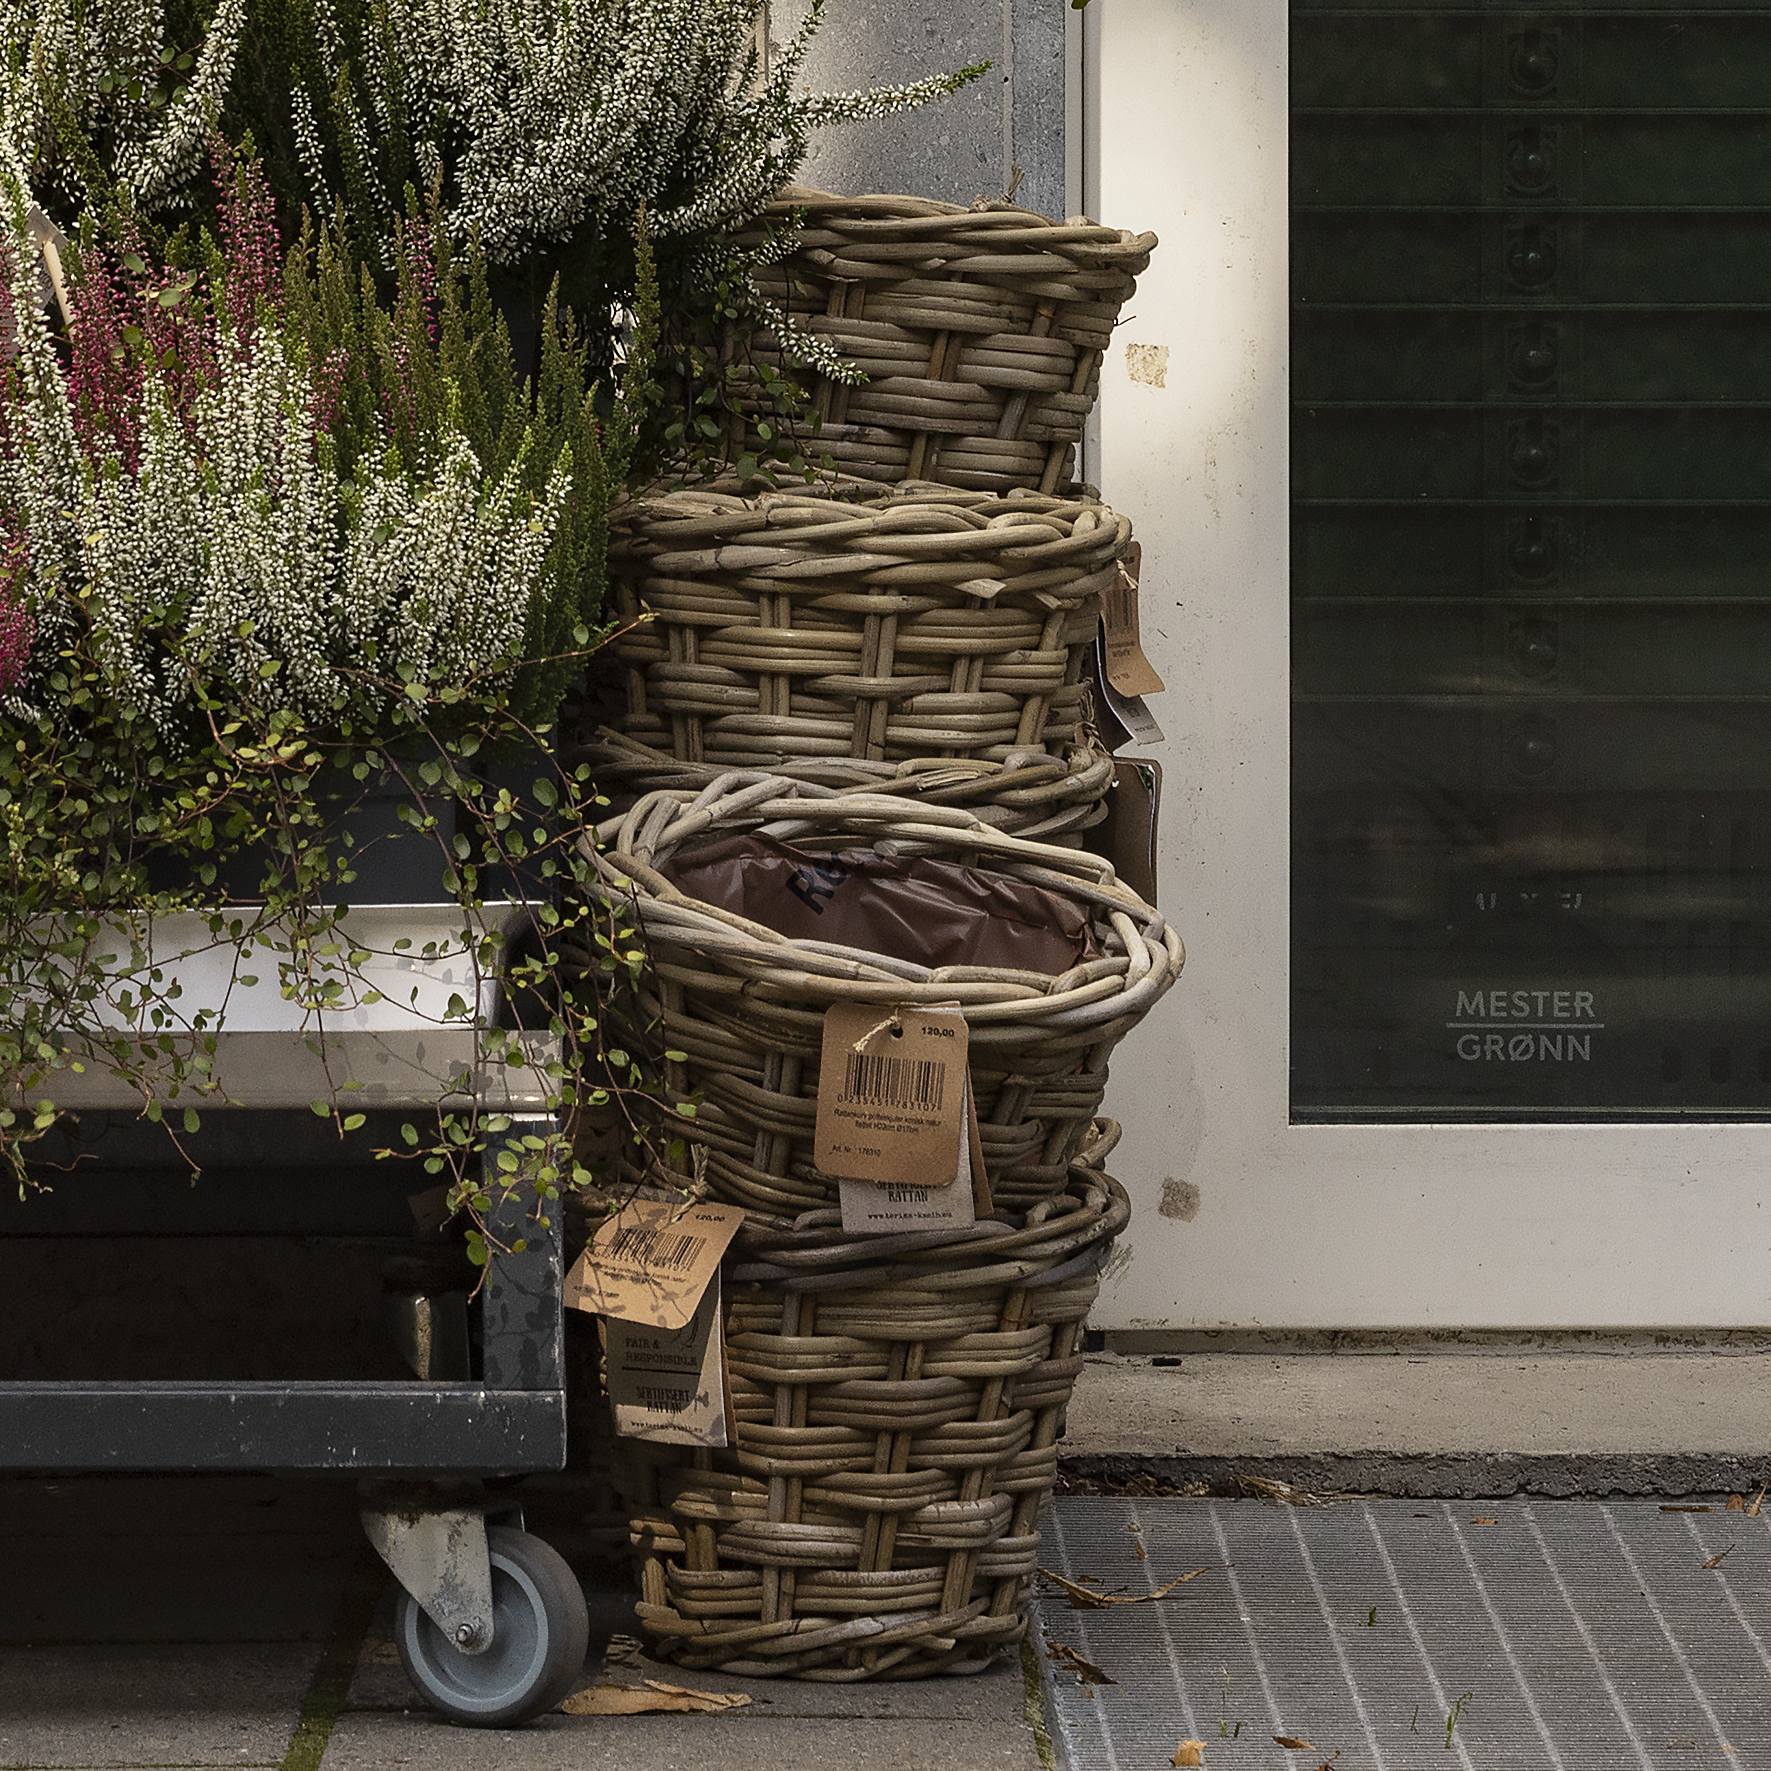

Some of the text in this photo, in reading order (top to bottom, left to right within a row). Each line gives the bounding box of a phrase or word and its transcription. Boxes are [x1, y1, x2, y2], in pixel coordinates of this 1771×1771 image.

[1456, 990, 1595, 1018] MESTER
[921, 1027, 955, 1038] 120,00
[1456, 1033, 1591, 1062] GRØNN
[888, 1190, 928, 1203] RATTAN
[625, 1337, 661, 1349] FAIR &
